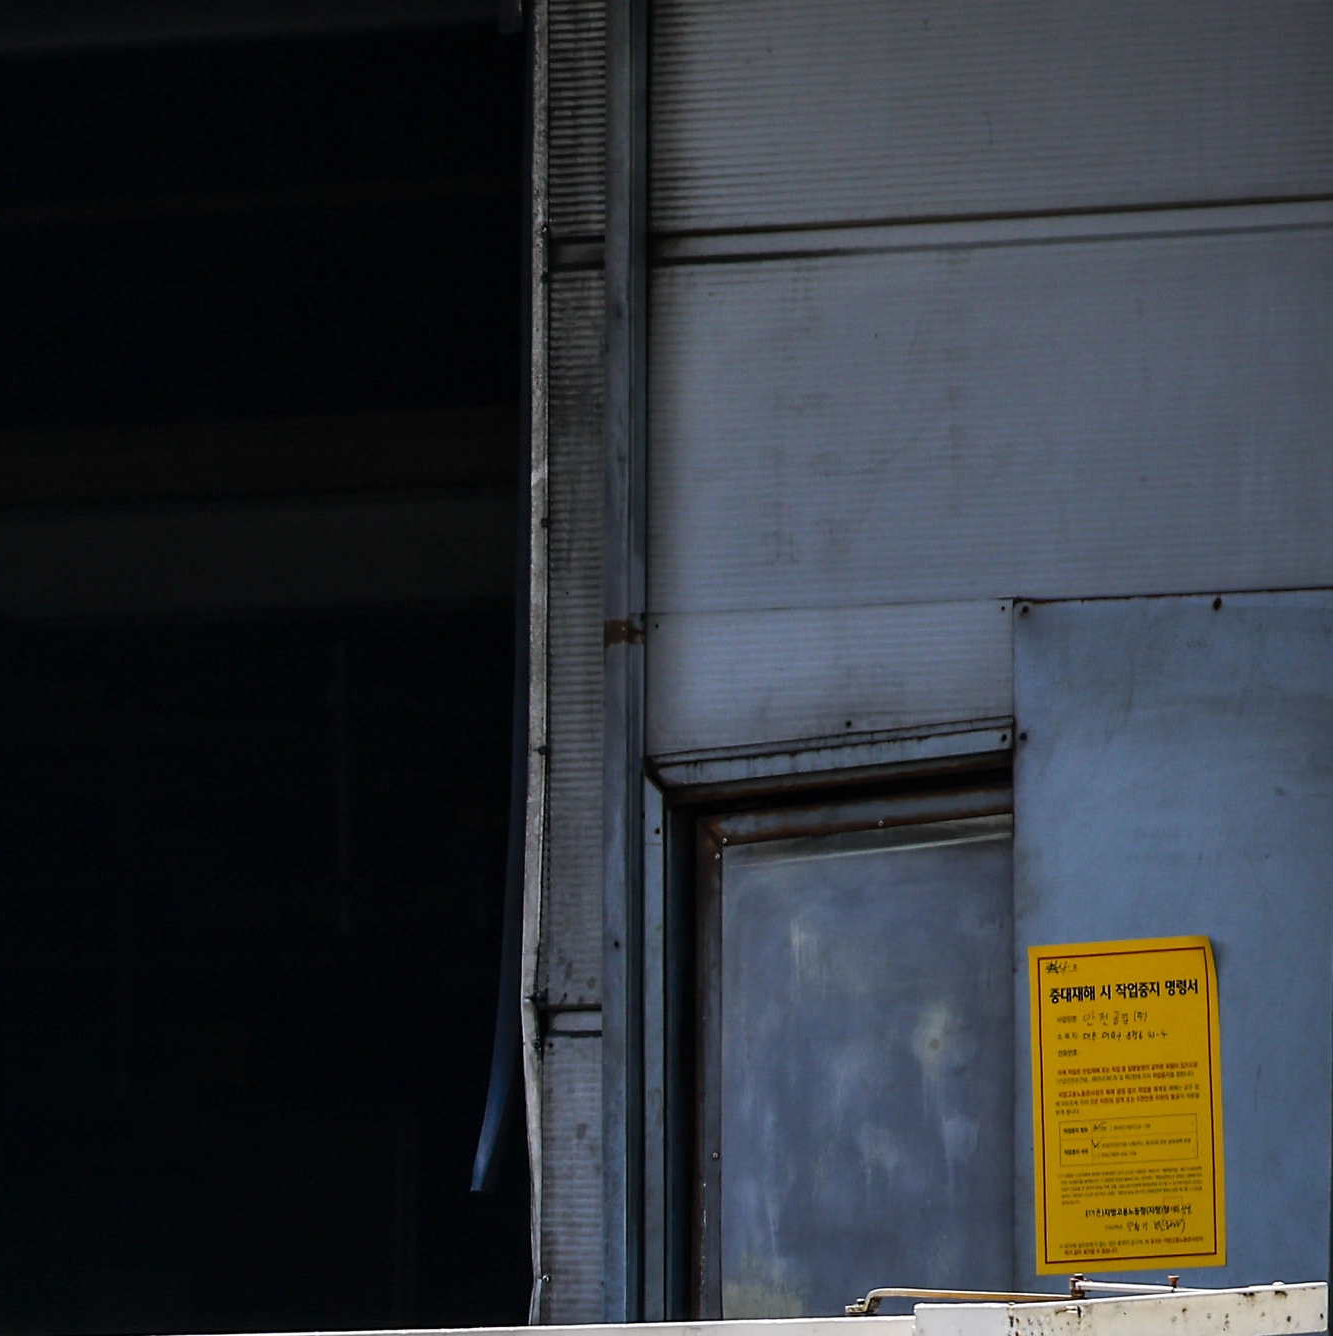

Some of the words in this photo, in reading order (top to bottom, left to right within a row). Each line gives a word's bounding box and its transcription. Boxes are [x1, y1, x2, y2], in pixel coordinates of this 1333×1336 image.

[1050, 985, 1095, 1004] 중대재해
[1100, 985, 1111, 999] 시
[1116, 981, 1160, 998] 작업중지
[1165, 979, 1198, 995] 명령서
